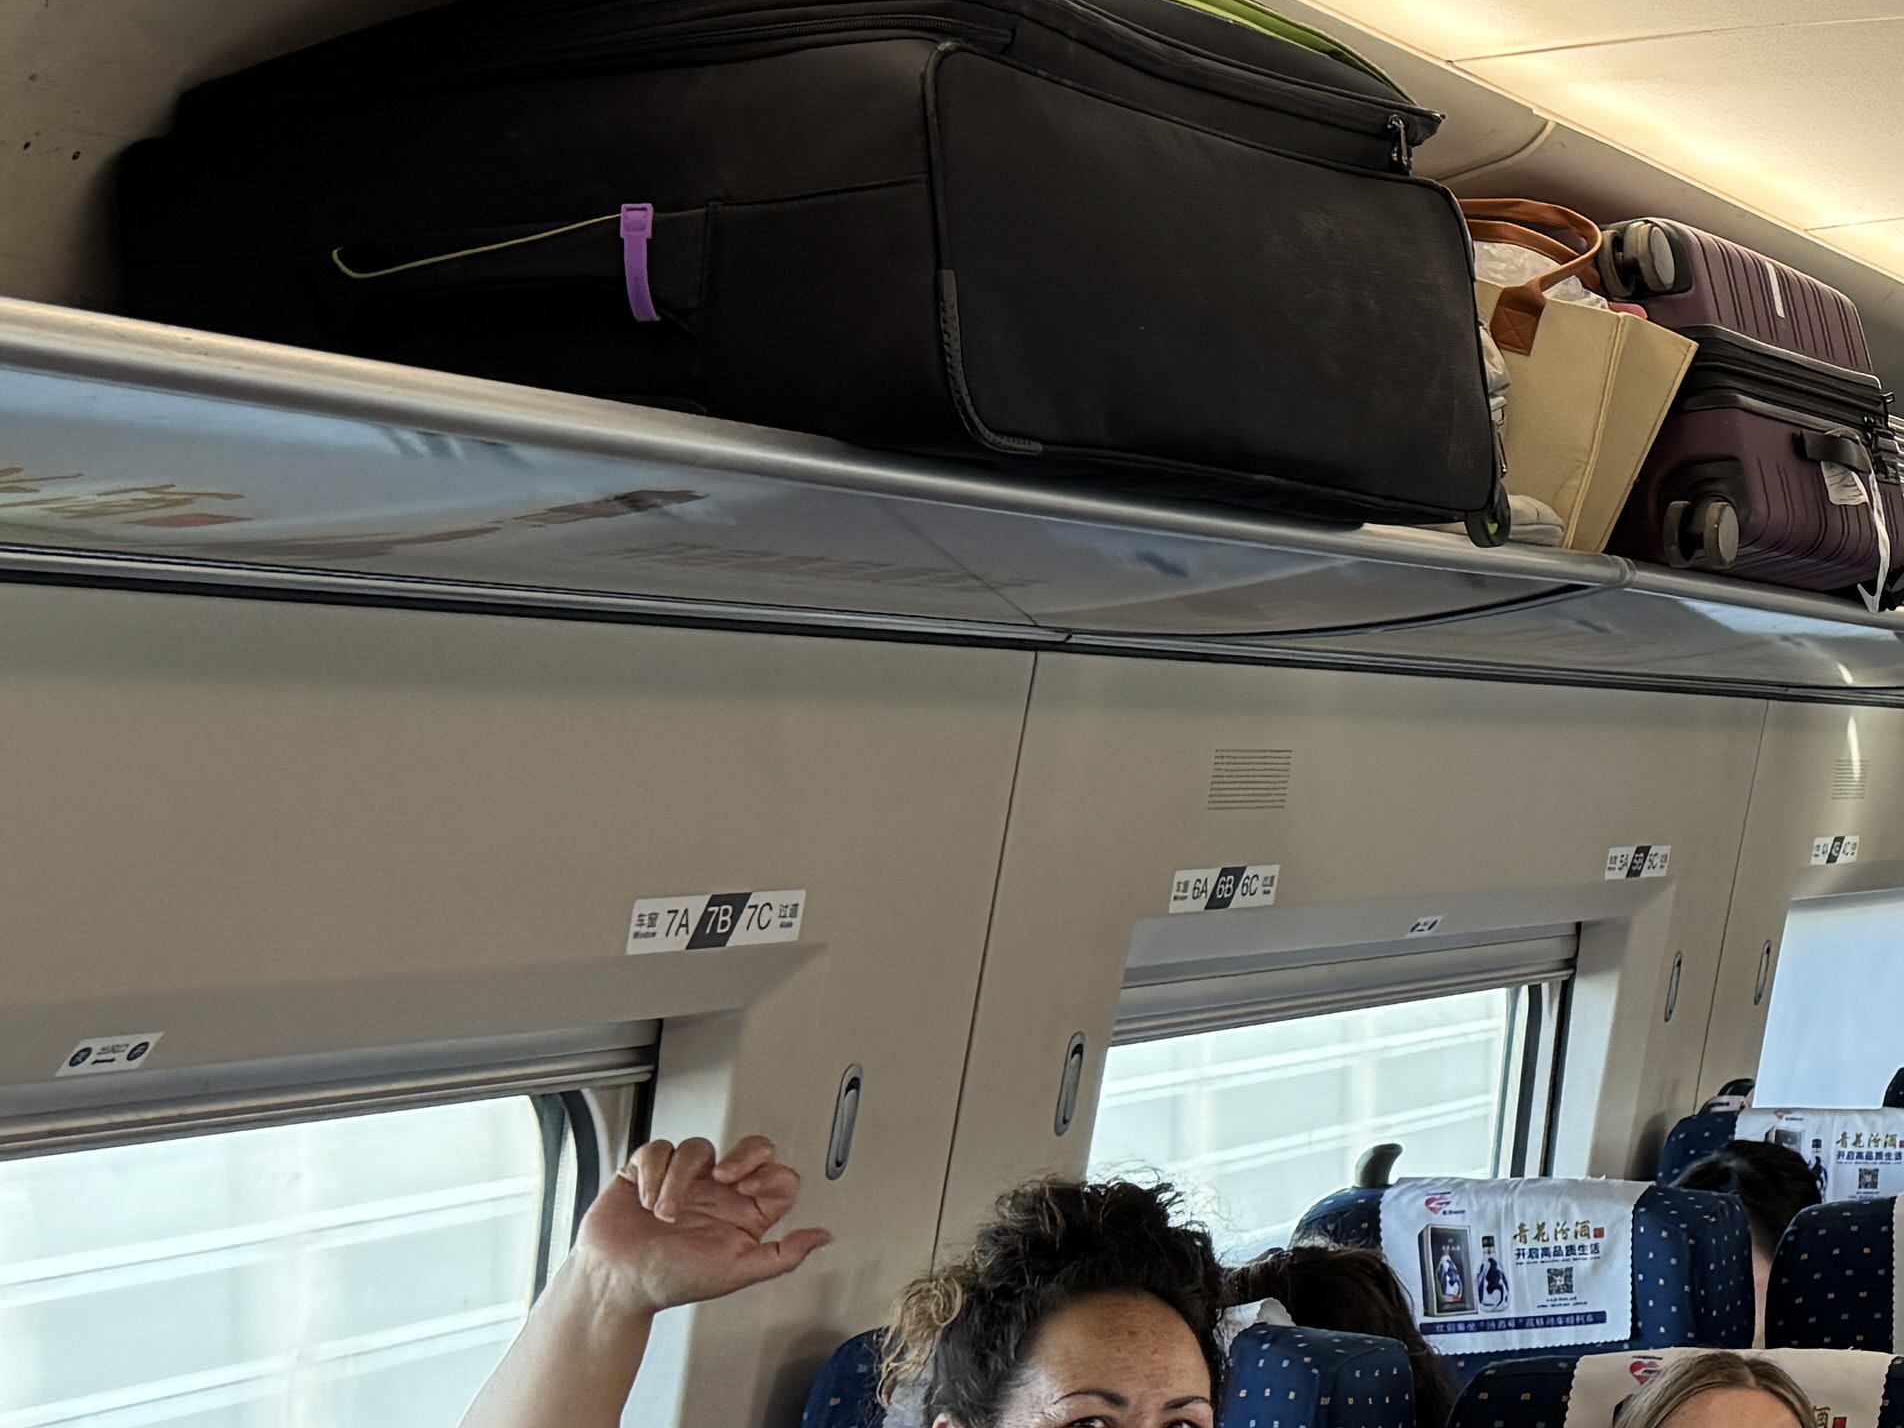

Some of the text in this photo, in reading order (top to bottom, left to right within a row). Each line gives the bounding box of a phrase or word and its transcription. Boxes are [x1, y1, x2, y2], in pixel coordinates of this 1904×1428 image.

[1192, 877, 1208, 900] 6A
[1216, 875, 1234, 899] 6B
[1241, 874, 1259, 896] 6C
[665, 908, 690, 937] 7A
[705, 904, 733, 934] 7B
[746, 902, 773, 931] 7C
